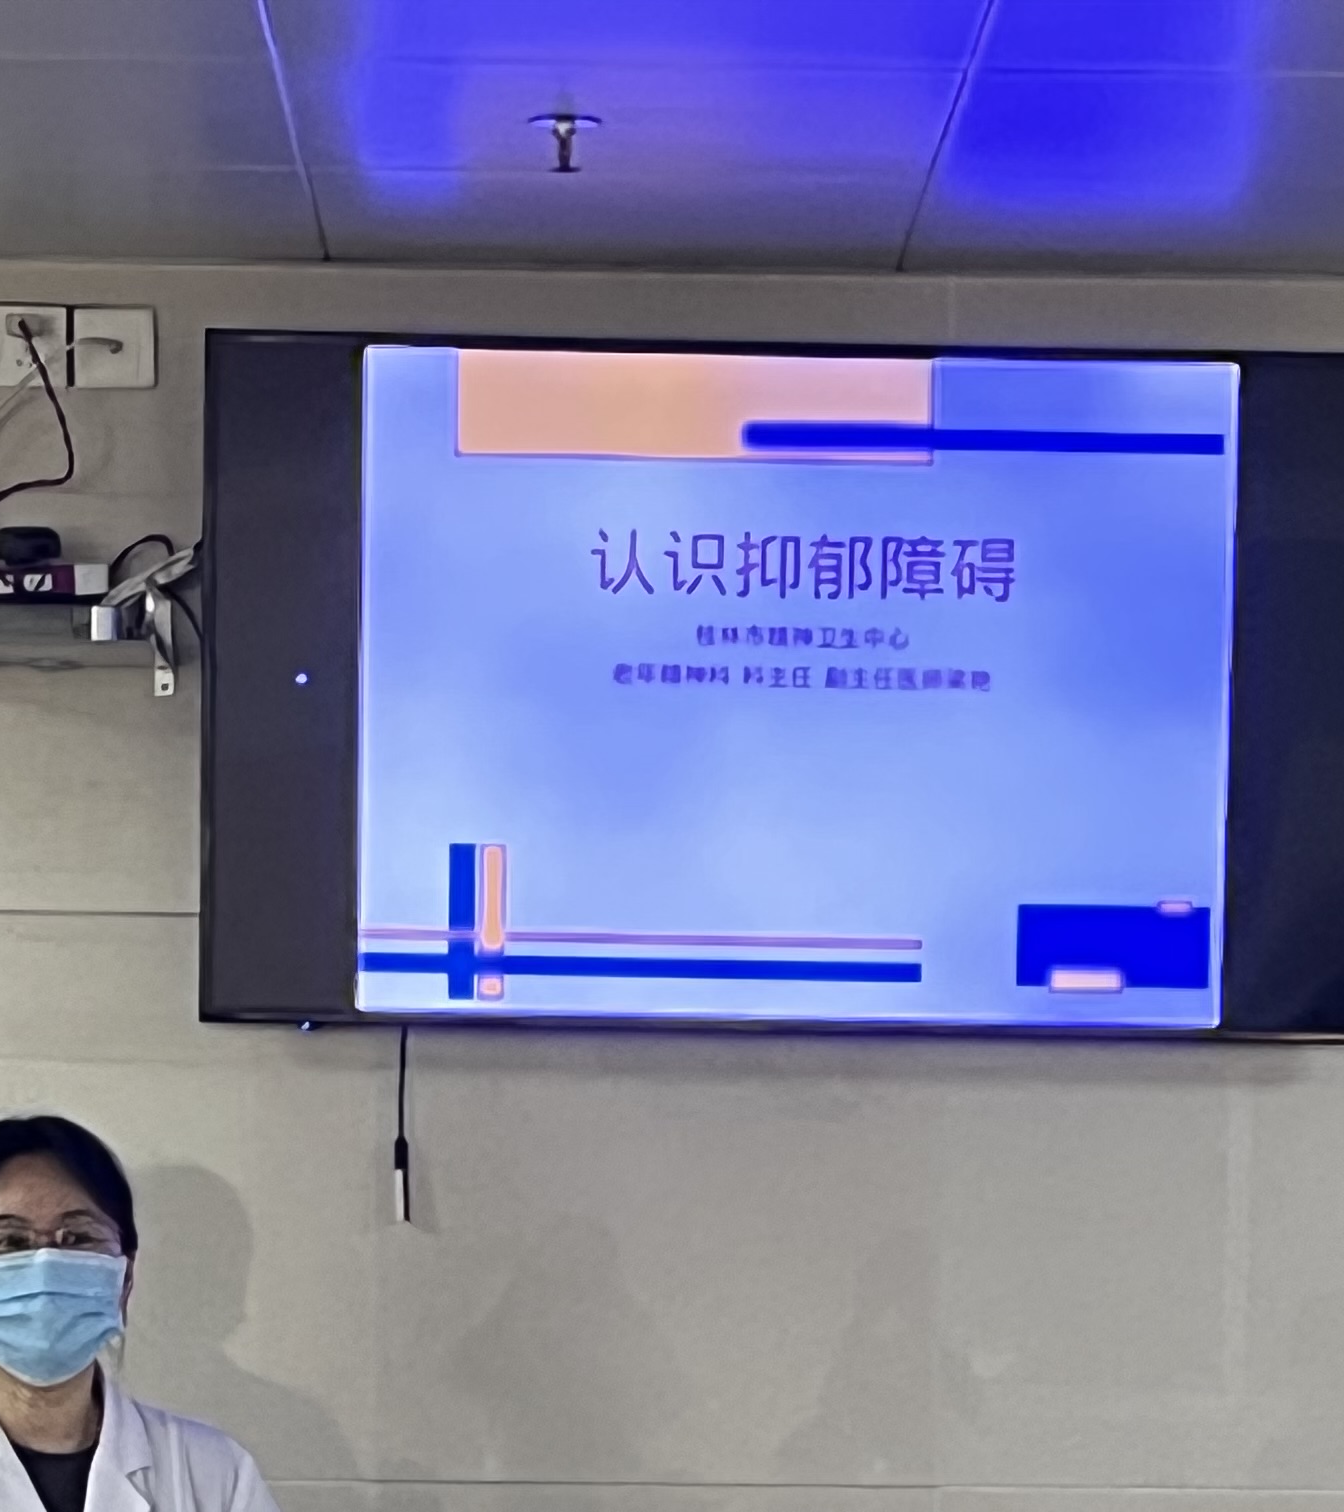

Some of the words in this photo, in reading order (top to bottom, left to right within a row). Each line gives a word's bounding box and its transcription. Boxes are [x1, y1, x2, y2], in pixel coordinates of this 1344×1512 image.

[590, 527, 1016, 602] 认识抑郁障碍
